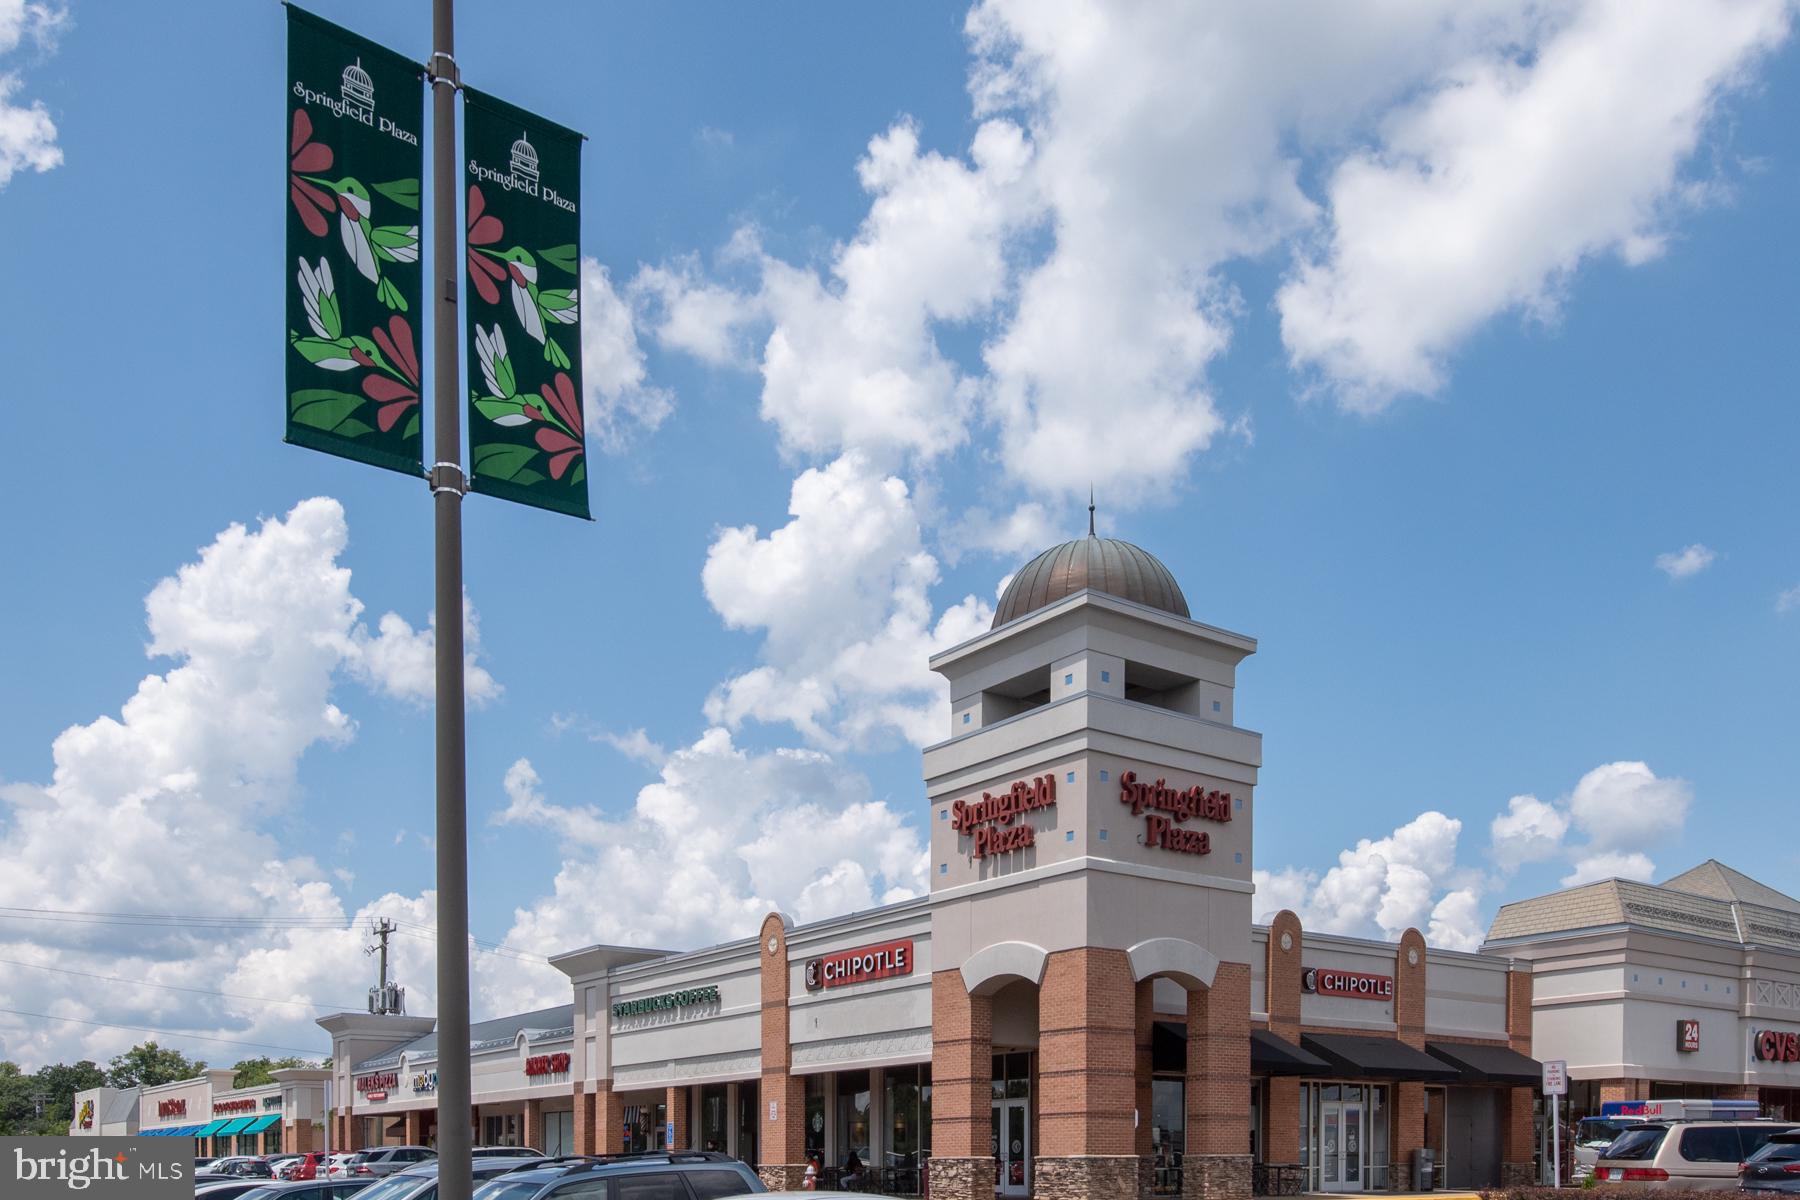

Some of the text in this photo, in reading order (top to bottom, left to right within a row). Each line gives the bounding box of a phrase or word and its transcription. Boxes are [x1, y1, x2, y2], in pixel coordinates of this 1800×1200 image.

[293, 81, 418, 146] Springfield Plaza
[468, 159, 577, 213] Springfield Plaza
[952, 774, 1056, 835] Springfield
[1120, 770, 1232, 823] Springfield
[973, 824, 1034, 859] Plaza
[1145, 815, 1211, 855] Plaza
[824, 948, 905, 980] CHIPOTLE
[612, 984, 718, 1017] STARBUCKS COFFEE
[1324, 974, 1392, 996] CHIPOTLE
[1685, 1023, 1699, 1041] 24
[1761, 1030, 1799, 1062] CVS
